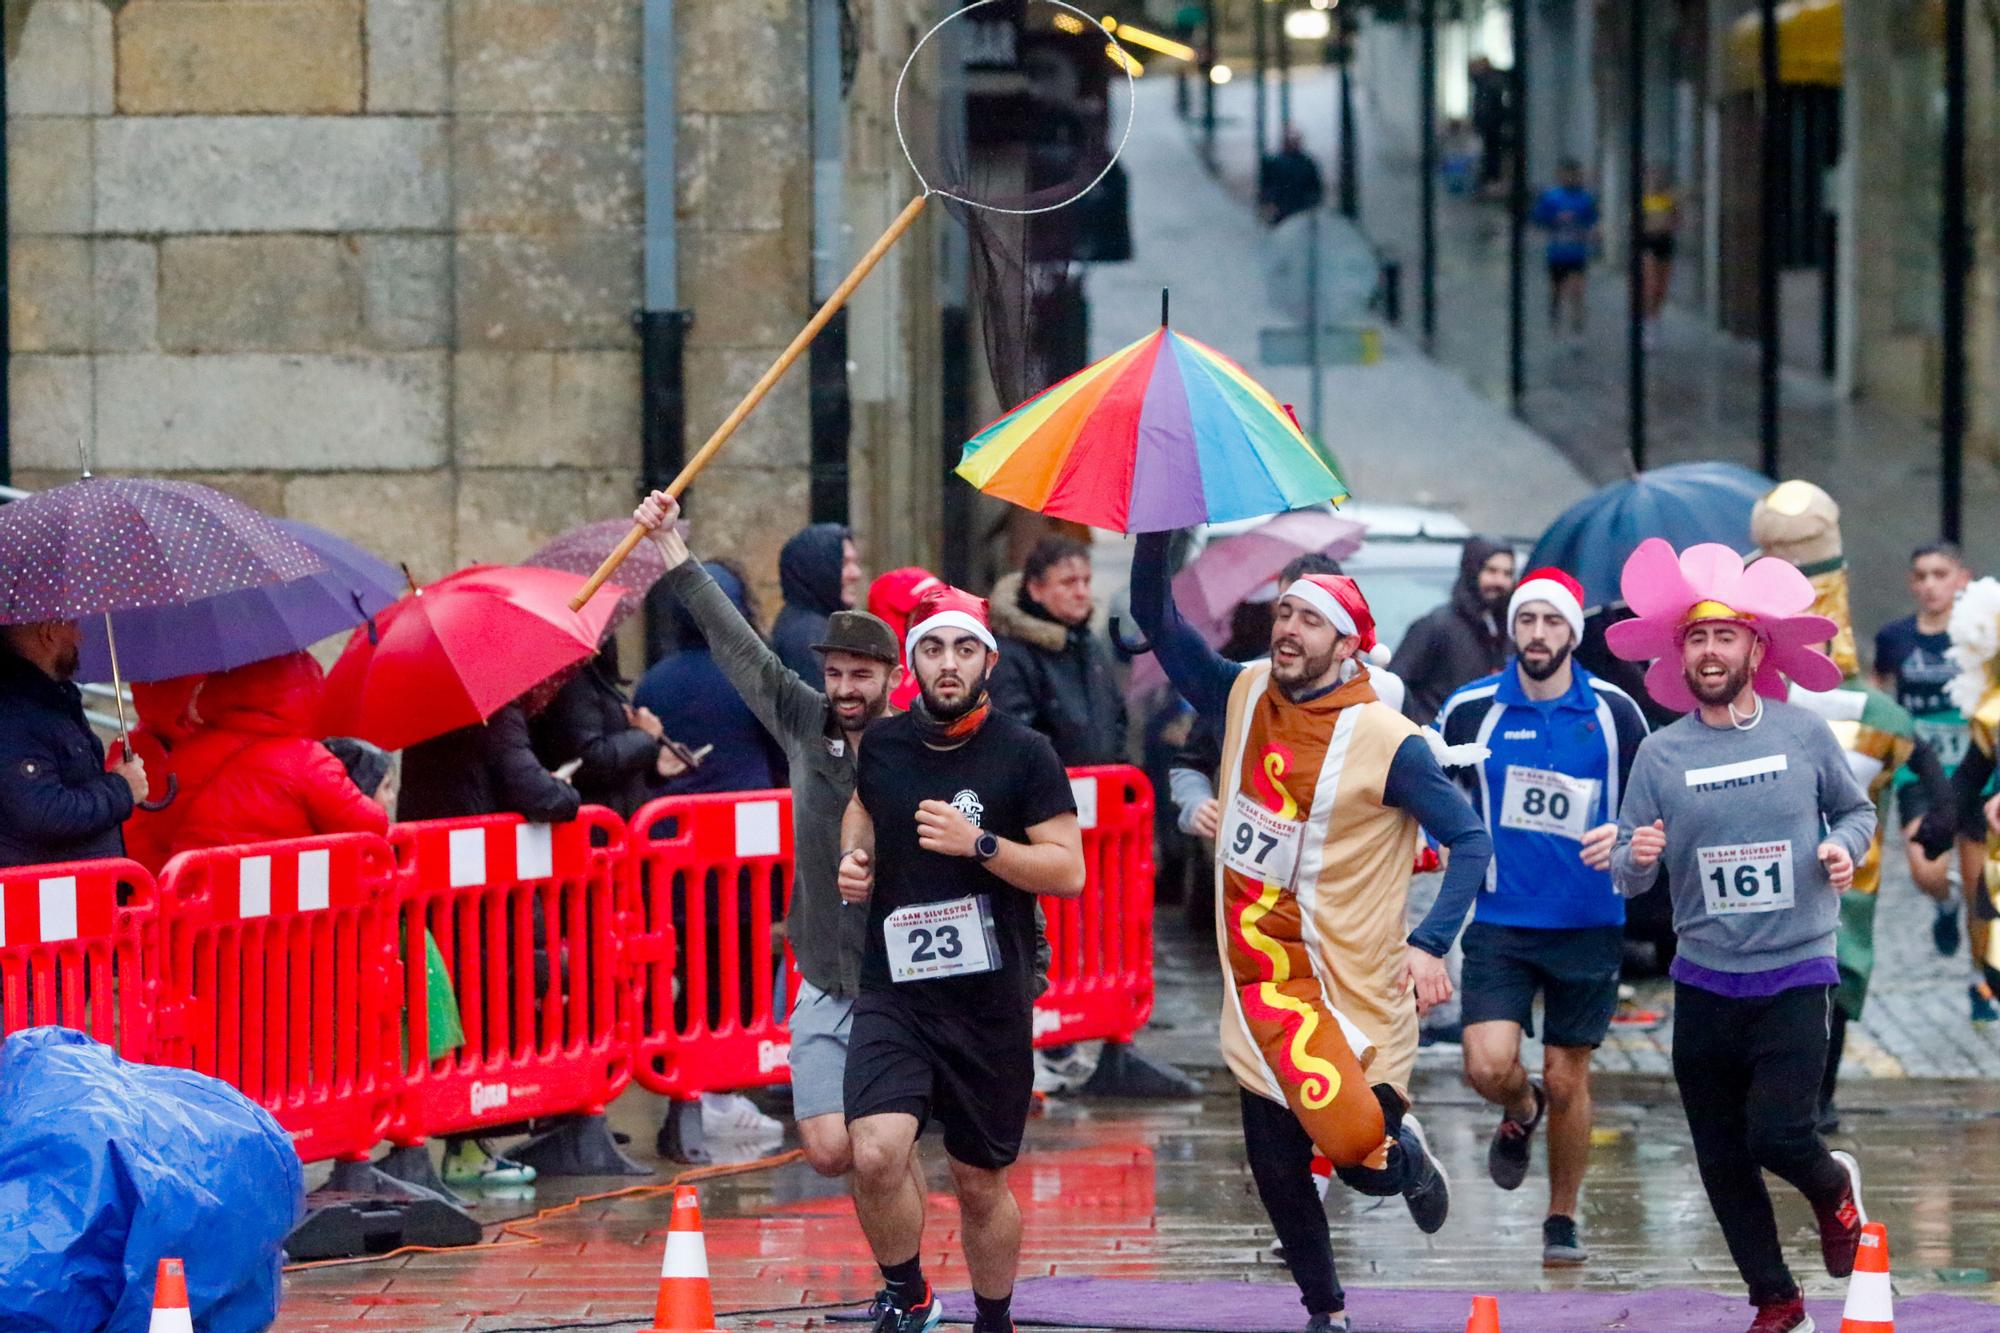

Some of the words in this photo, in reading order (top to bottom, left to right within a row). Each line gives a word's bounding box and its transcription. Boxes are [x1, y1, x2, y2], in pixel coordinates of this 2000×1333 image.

[1523, 787, 1570, 820] 80
[1232, 822, 1279, 864] 97
[1740, 844, 1787, 856] SILVESTRE
[1709, 862, 1782, 898] 161
[901, 912, 921, 920] SAN
[923, 903, 973, 918] SILVESTRE
[908, 925, 963, 963] 23
